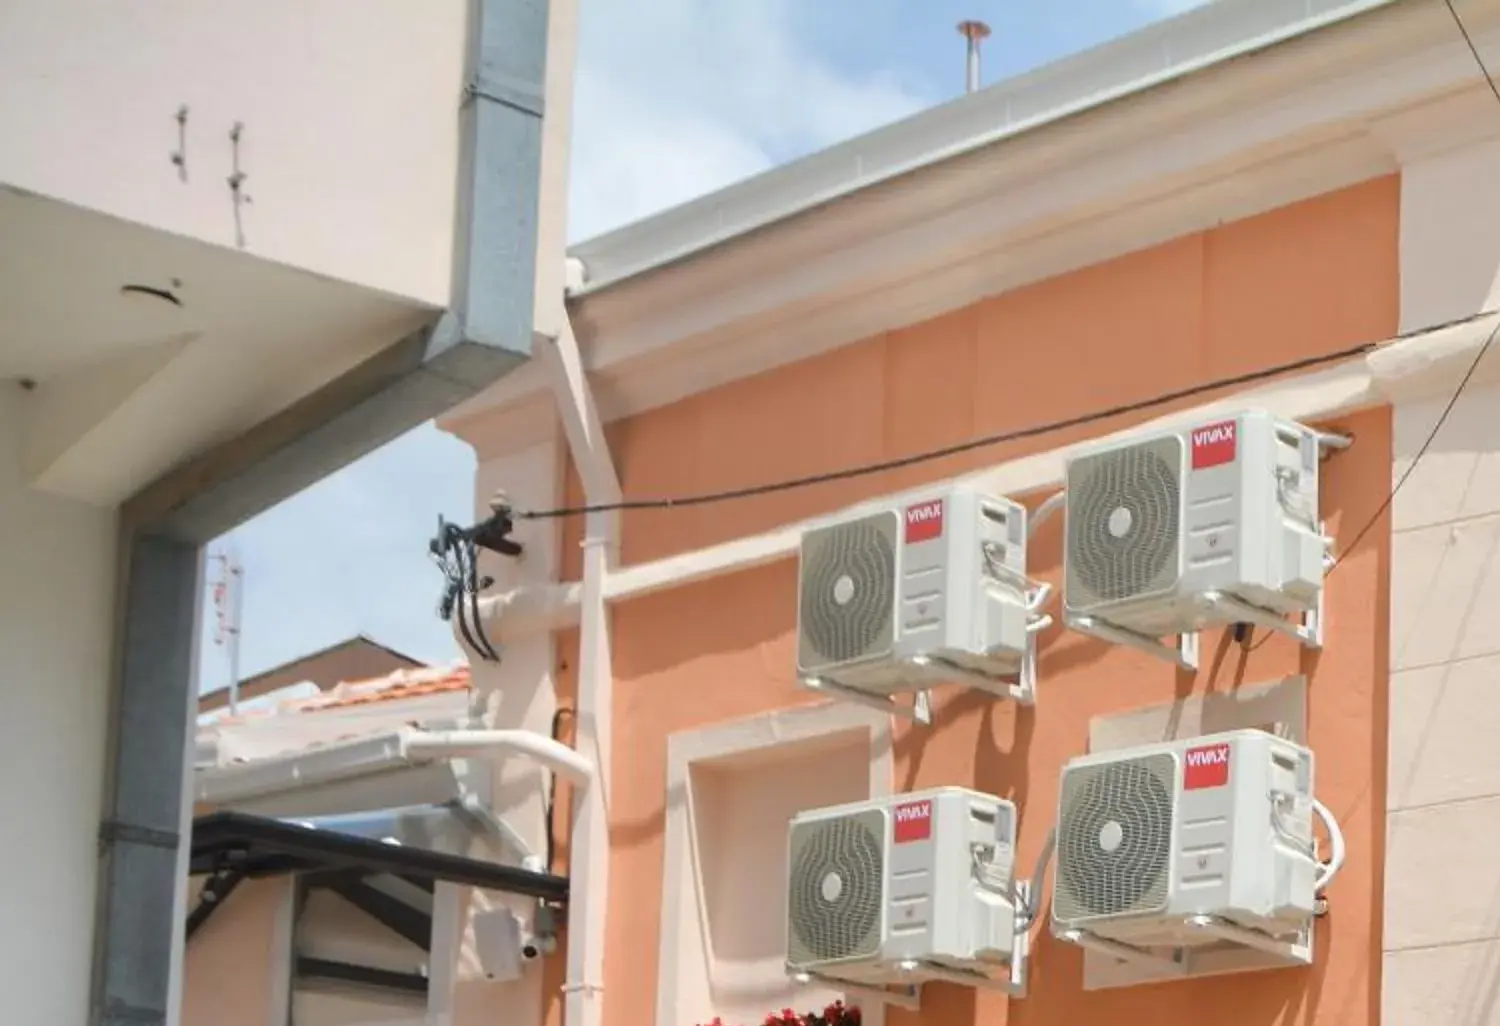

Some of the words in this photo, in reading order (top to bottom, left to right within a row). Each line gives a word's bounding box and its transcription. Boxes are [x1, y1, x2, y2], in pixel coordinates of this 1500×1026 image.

[1194, 424, 1233, 447] VIVAX
[908, 504, 941, 523] VIVAX
[1188, 747, 1227, 766] VIVAX
